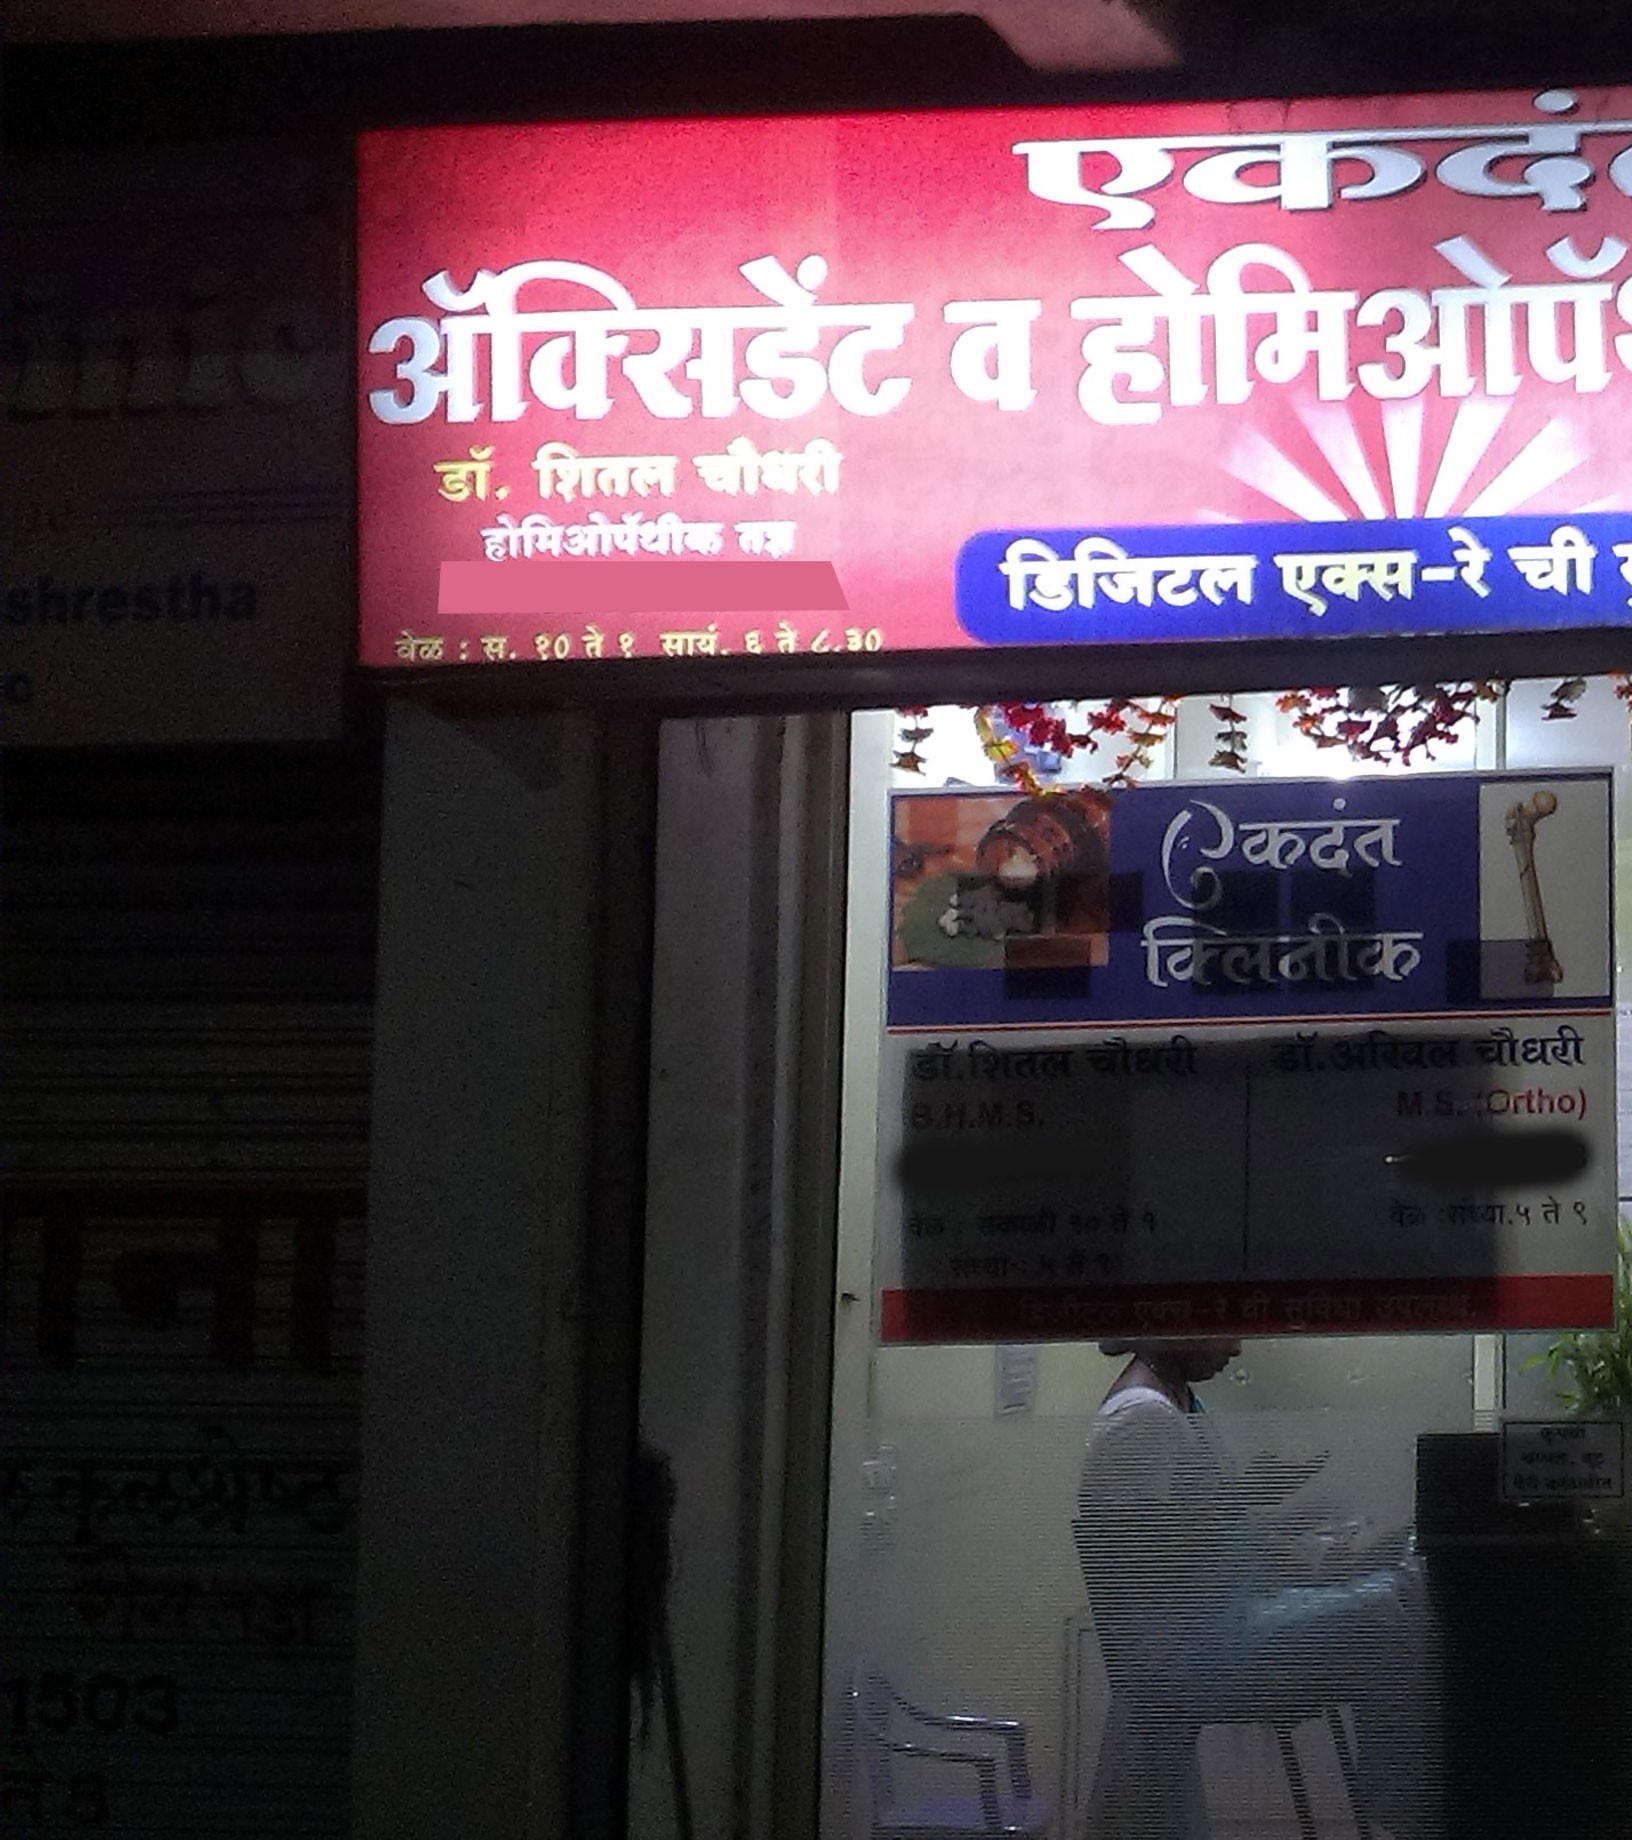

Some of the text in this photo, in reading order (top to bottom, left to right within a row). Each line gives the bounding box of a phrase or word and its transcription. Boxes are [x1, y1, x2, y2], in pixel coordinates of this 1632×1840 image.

[944, 298, 1042, 414] व
[432, 435, 845, 503] डॉ. शितल चौधरी
[733, 519, 798, 561] तज्ञ
[1000, 535, 1255, 614] डिजिटल
[1275, 525, 1490, 618] एक्स-रे
[1507, 527, 1598, 599] ची
[395, 629, 445, 662] वेळ
[534, 632, 571, 660] १०
[582, 623, 605, 659] ते
[744, 629, 764, 656] ६
[775, 621, 799, 656] ते
[1140, 912, 1425, 988] क्लिनीक
[1086, 1034, 1199, 1077] चौधरी
[1476, 1024, 1586, 1067] चौधरी
[1396, 1087, 1588, 1120] M.S. (Ortho)
[1542, 1196, 1560, 1226] ते
[1574, 1201, 1588, 1226] ९
